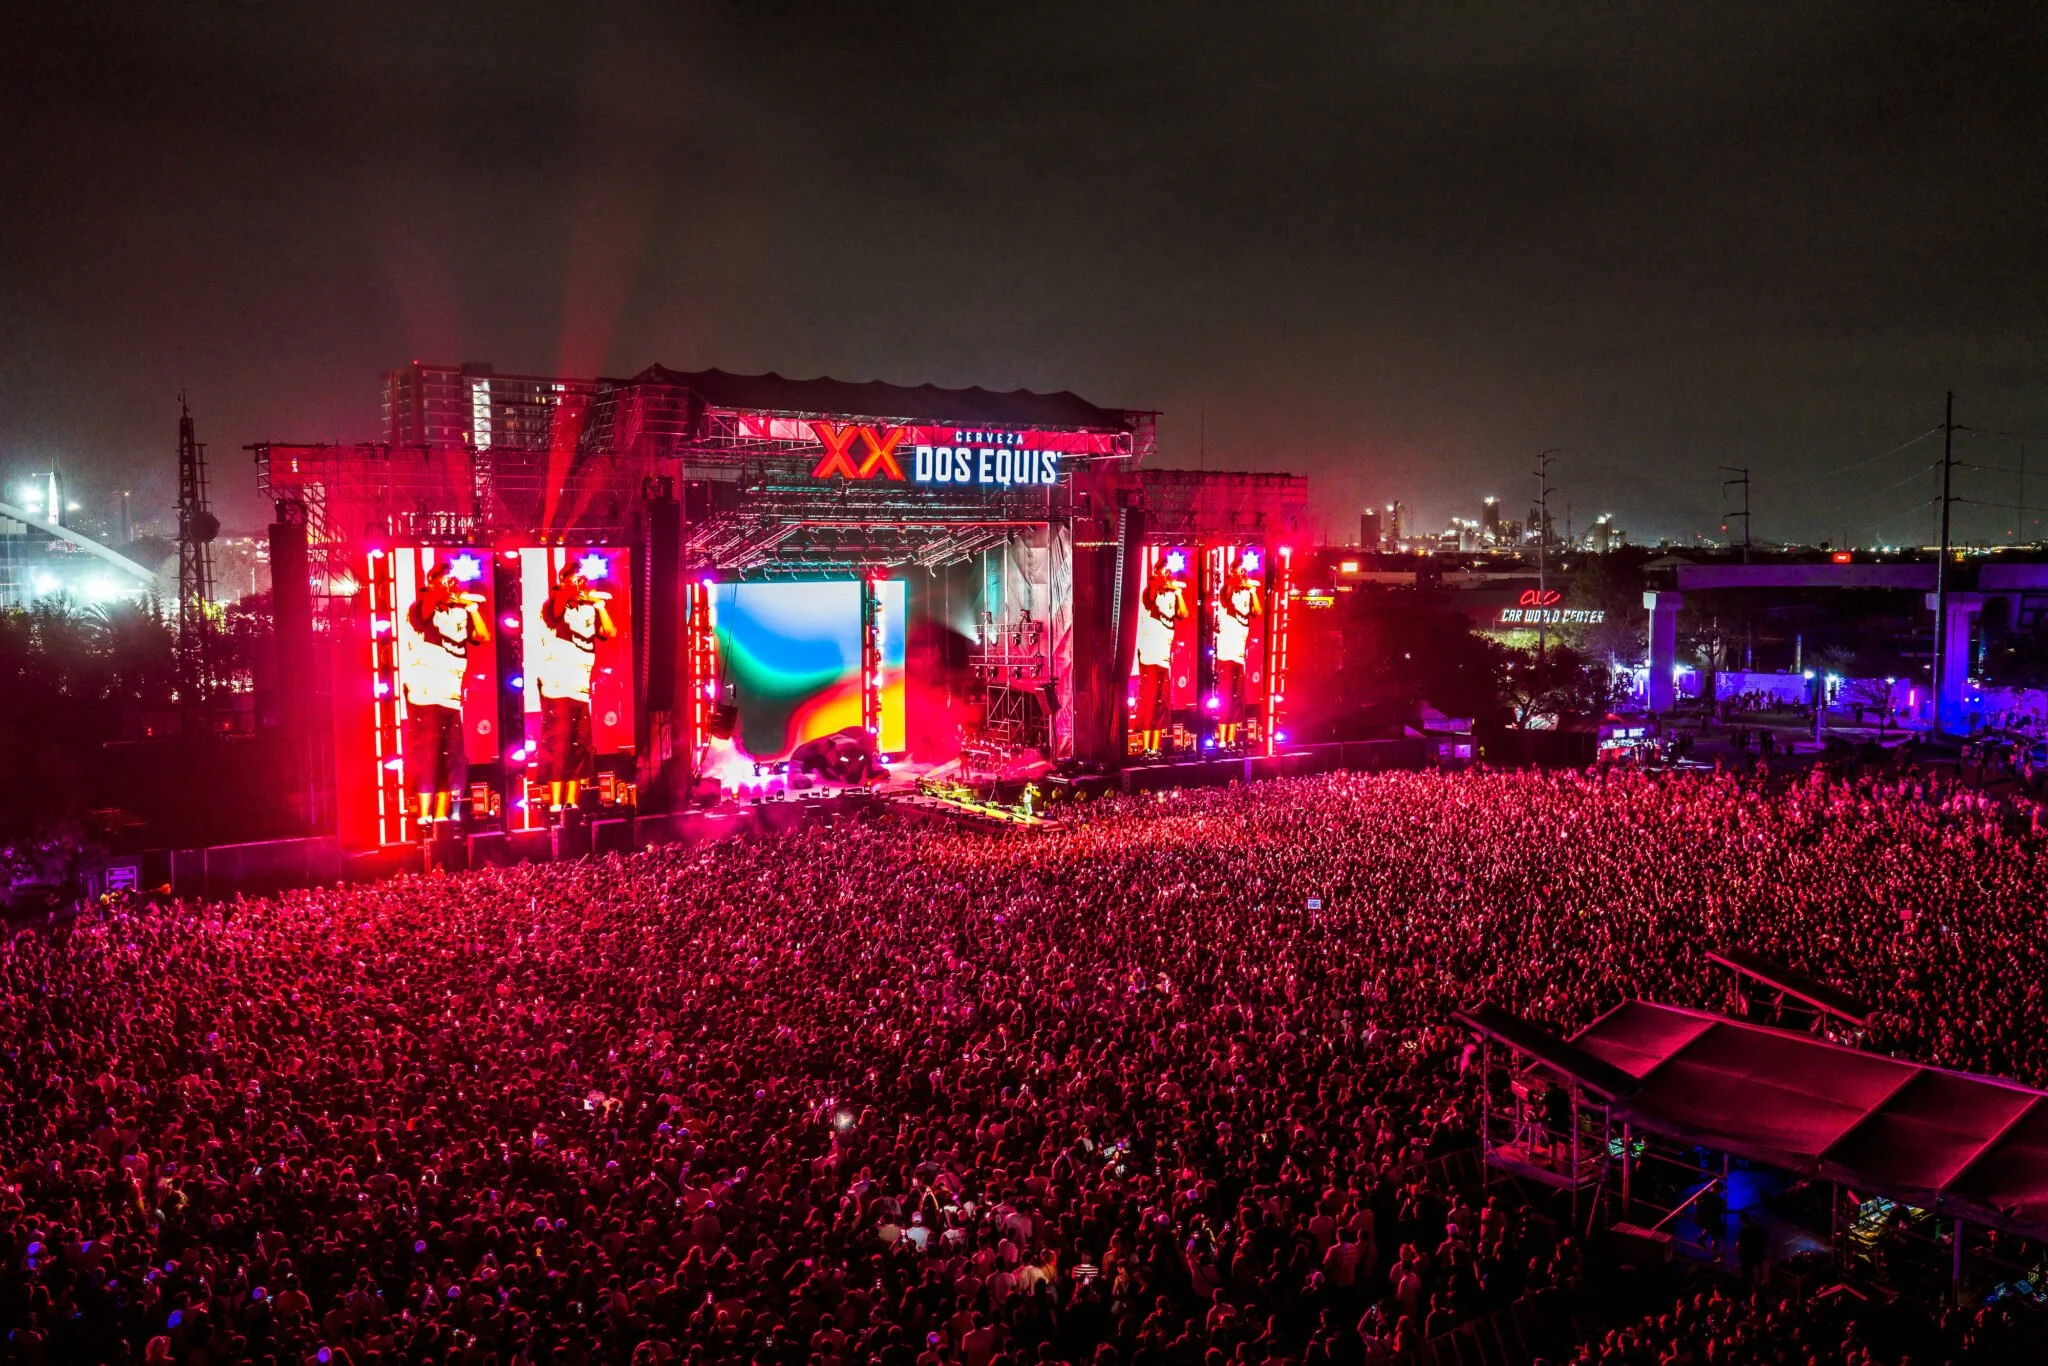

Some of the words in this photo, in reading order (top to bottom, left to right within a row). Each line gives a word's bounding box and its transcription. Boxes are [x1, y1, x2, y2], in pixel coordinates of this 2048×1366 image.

[810, 422, 905, 481] XX
[955, 431, 1024, 445] CERVEZA
[915, 446, 971, 482] DOS
[979, 448, 1056, 486] EQUIS
[1501, 609, 1522, 622] CAR
[1562, 609, 1604, 624] CENTER
